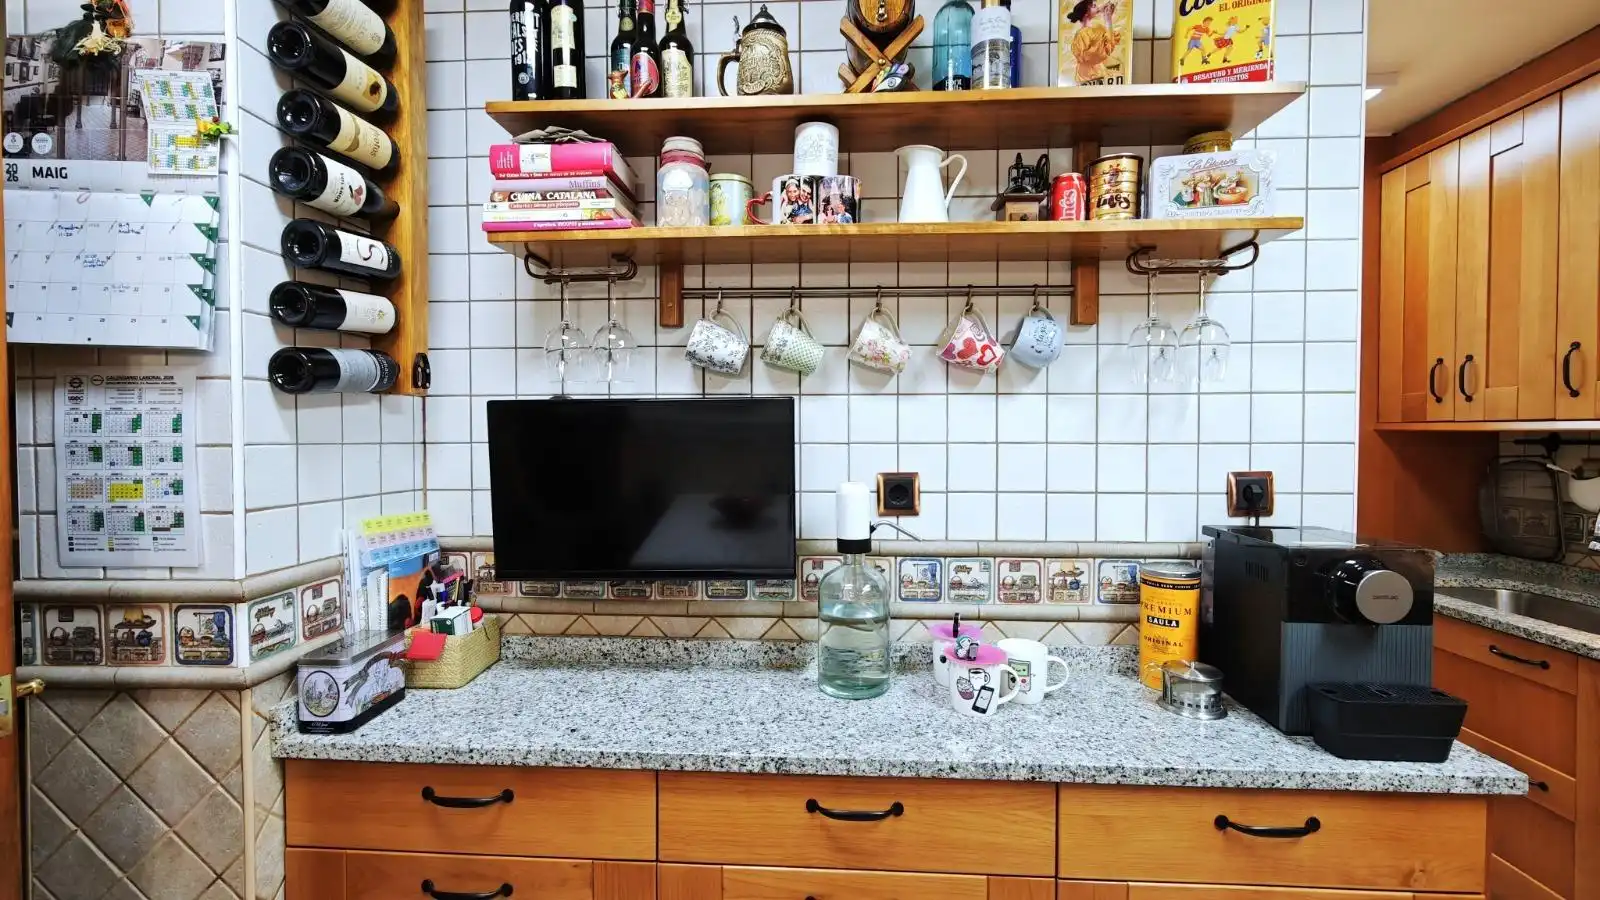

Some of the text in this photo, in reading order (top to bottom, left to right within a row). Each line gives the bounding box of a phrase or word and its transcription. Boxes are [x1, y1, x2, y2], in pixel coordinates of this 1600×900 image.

[1219, 3, 1230, 12] EL
[1233, 62, 1268, 74] MERIENDA
[6, 164, 68, 180] 20 MAIG
[7, 173, 18, 182] 26
[568, 180, 600, 188] Muffins
[510, 191, 596, 201] CUINA CATALANA
[1148, 617, 1177, 627] SAULA
[1144, 635, 1184, 647] ORIGINAL
